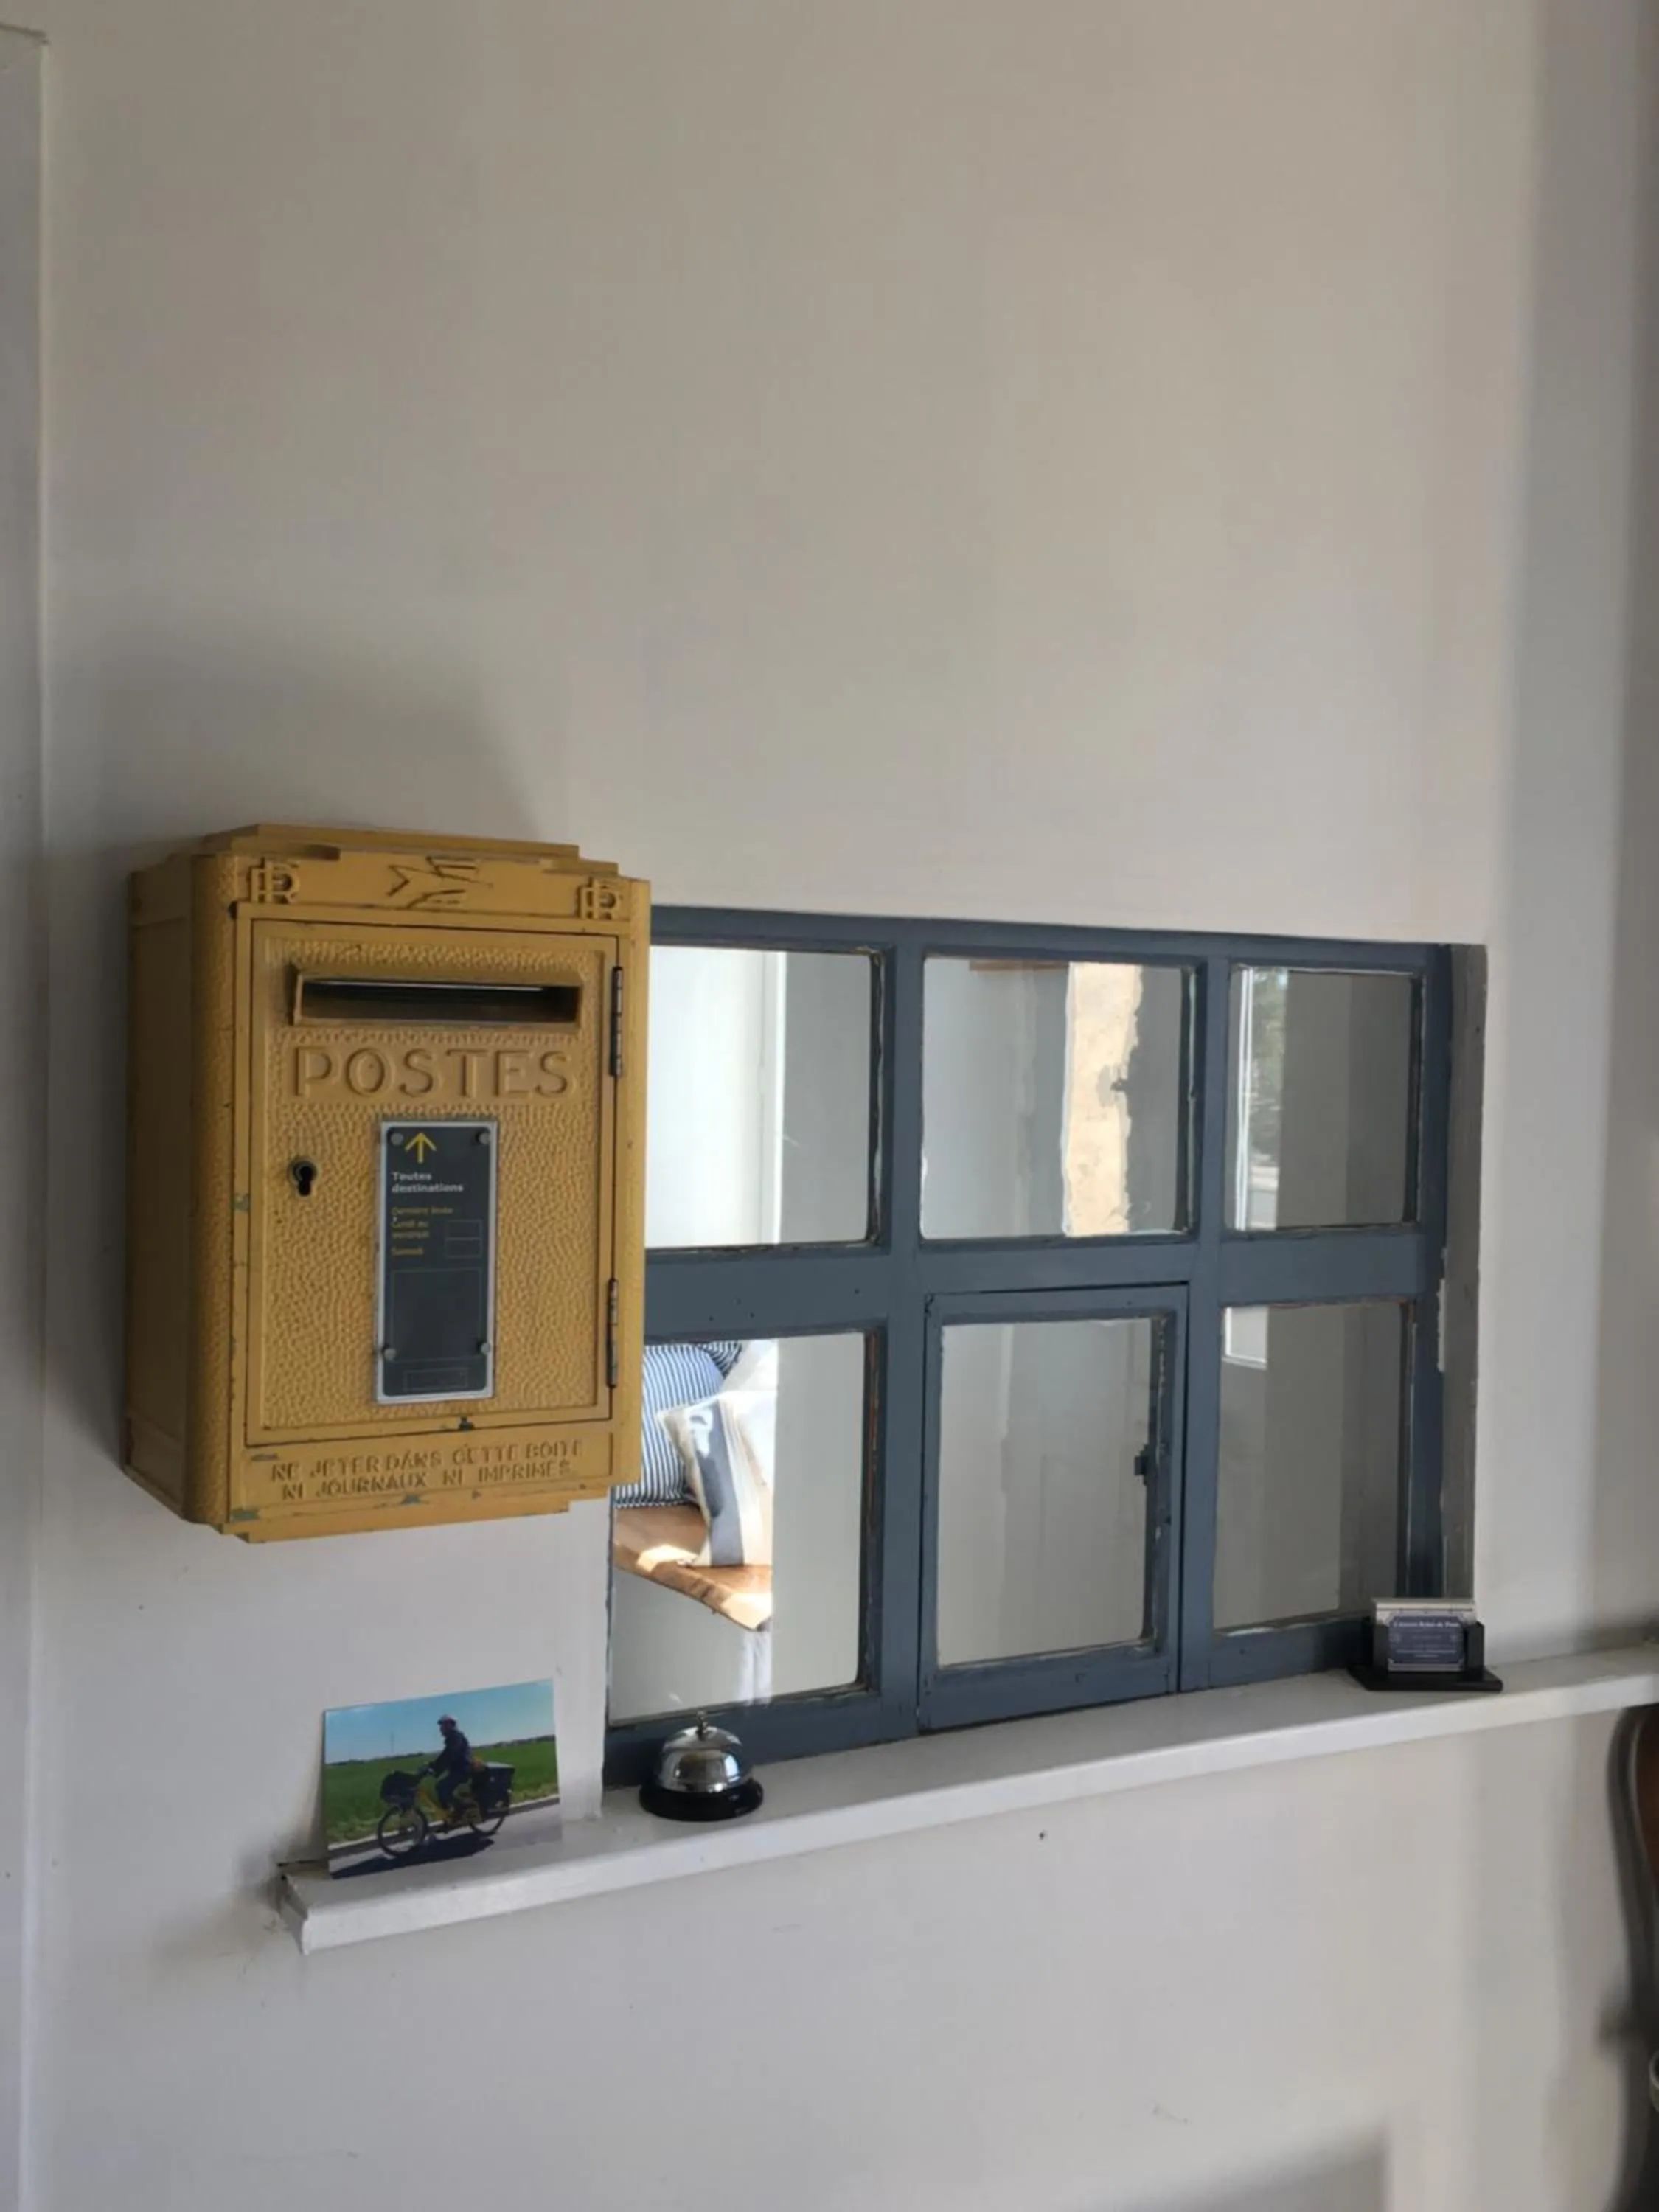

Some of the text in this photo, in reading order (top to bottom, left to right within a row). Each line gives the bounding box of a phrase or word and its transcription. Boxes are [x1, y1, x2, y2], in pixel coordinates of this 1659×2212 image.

[294, 1044, 577, 1099] POSTES
[392, 1171, 433, 1181] Toutes
[392, 1182, 464, 1193] destinations
[272, 1461, 300, 1483] NE
[309, 1455, 382, 1478] JETER
[386, 1450, 442, 1472] DANS
[451, 1443, 518, 1466] CETTE
[281, 1481, 305, 1501] NI
[316, 1472, 428, 1498] JOURNAUX
[442, 1467, 464, 1486] NI
